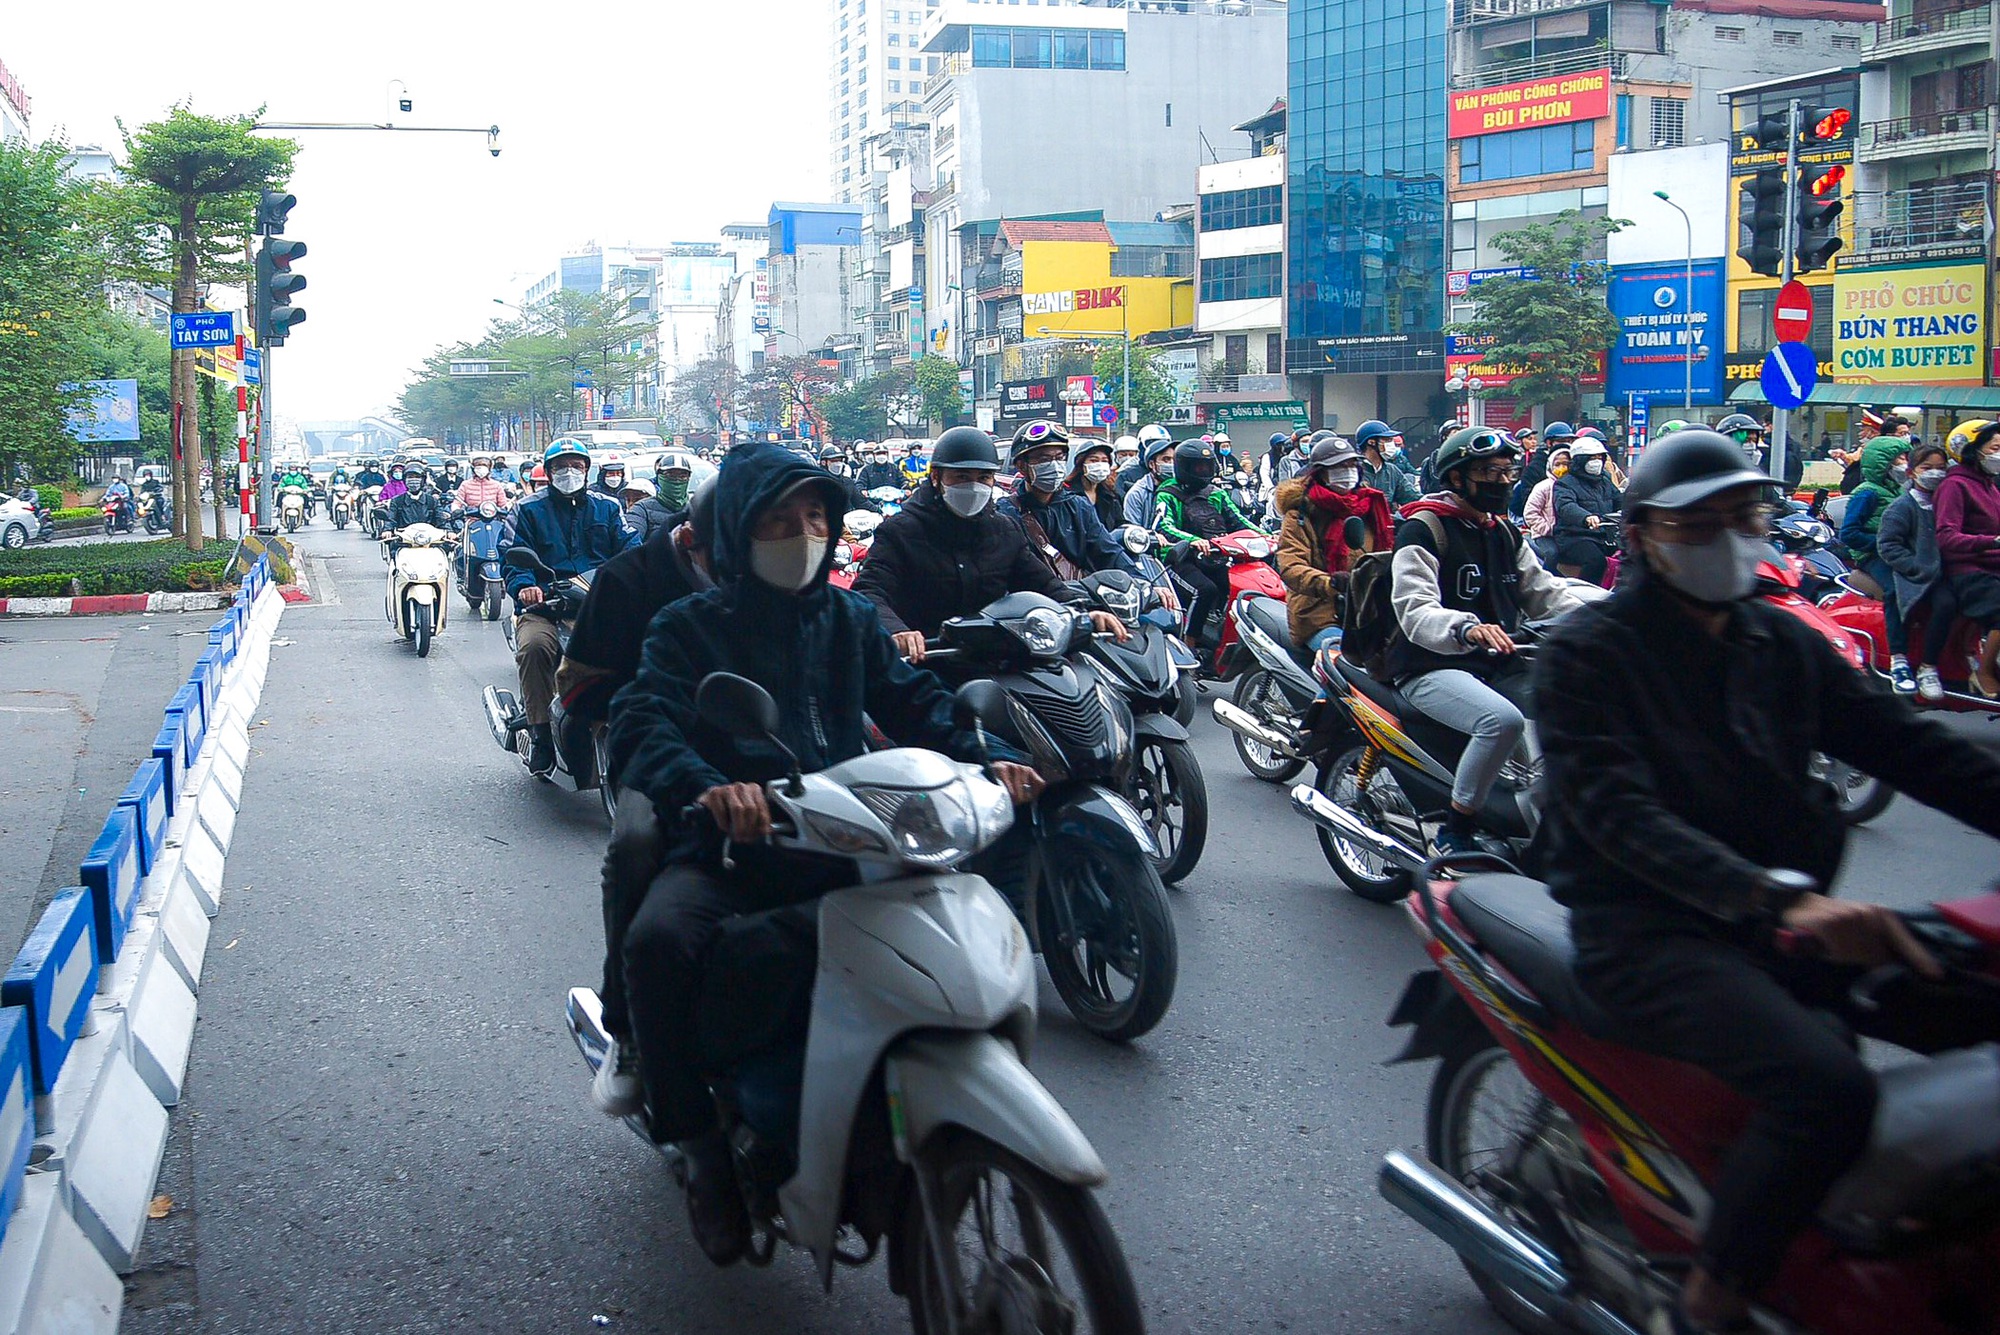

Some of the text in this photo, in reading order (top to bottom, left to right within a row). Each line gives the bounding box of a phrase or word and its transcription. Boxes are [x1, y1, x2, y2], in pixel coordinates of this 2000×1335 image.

[1455, 76, 1603, 111] VĂN PHÒNG CÔNG CHỨNG
[1483, 100, 1571, 128] BÙI PHƠN
[1021, 291, 1074, 315] GANG
[1845, 279, 1973, 310] PHỞ CHÚC
[195, 315, 215, 326] PHỐ
[1838, 314, 1978, 340] BÚN THANG
[176, 328, 229, 343] TÂY SƠN
[1625, 326, 1704, 347] TOÀN MỸ
[1841, 346, 1885, 369] CƠM
[1891, 344, 1976, 367] BUFFET
[1175, 408, 1190, 419] DA
[1268, 405, 1284, 416] MÁY
[1285, 405, 1304, 415] TÍNH
[1457, 564, 1480, 600] C
